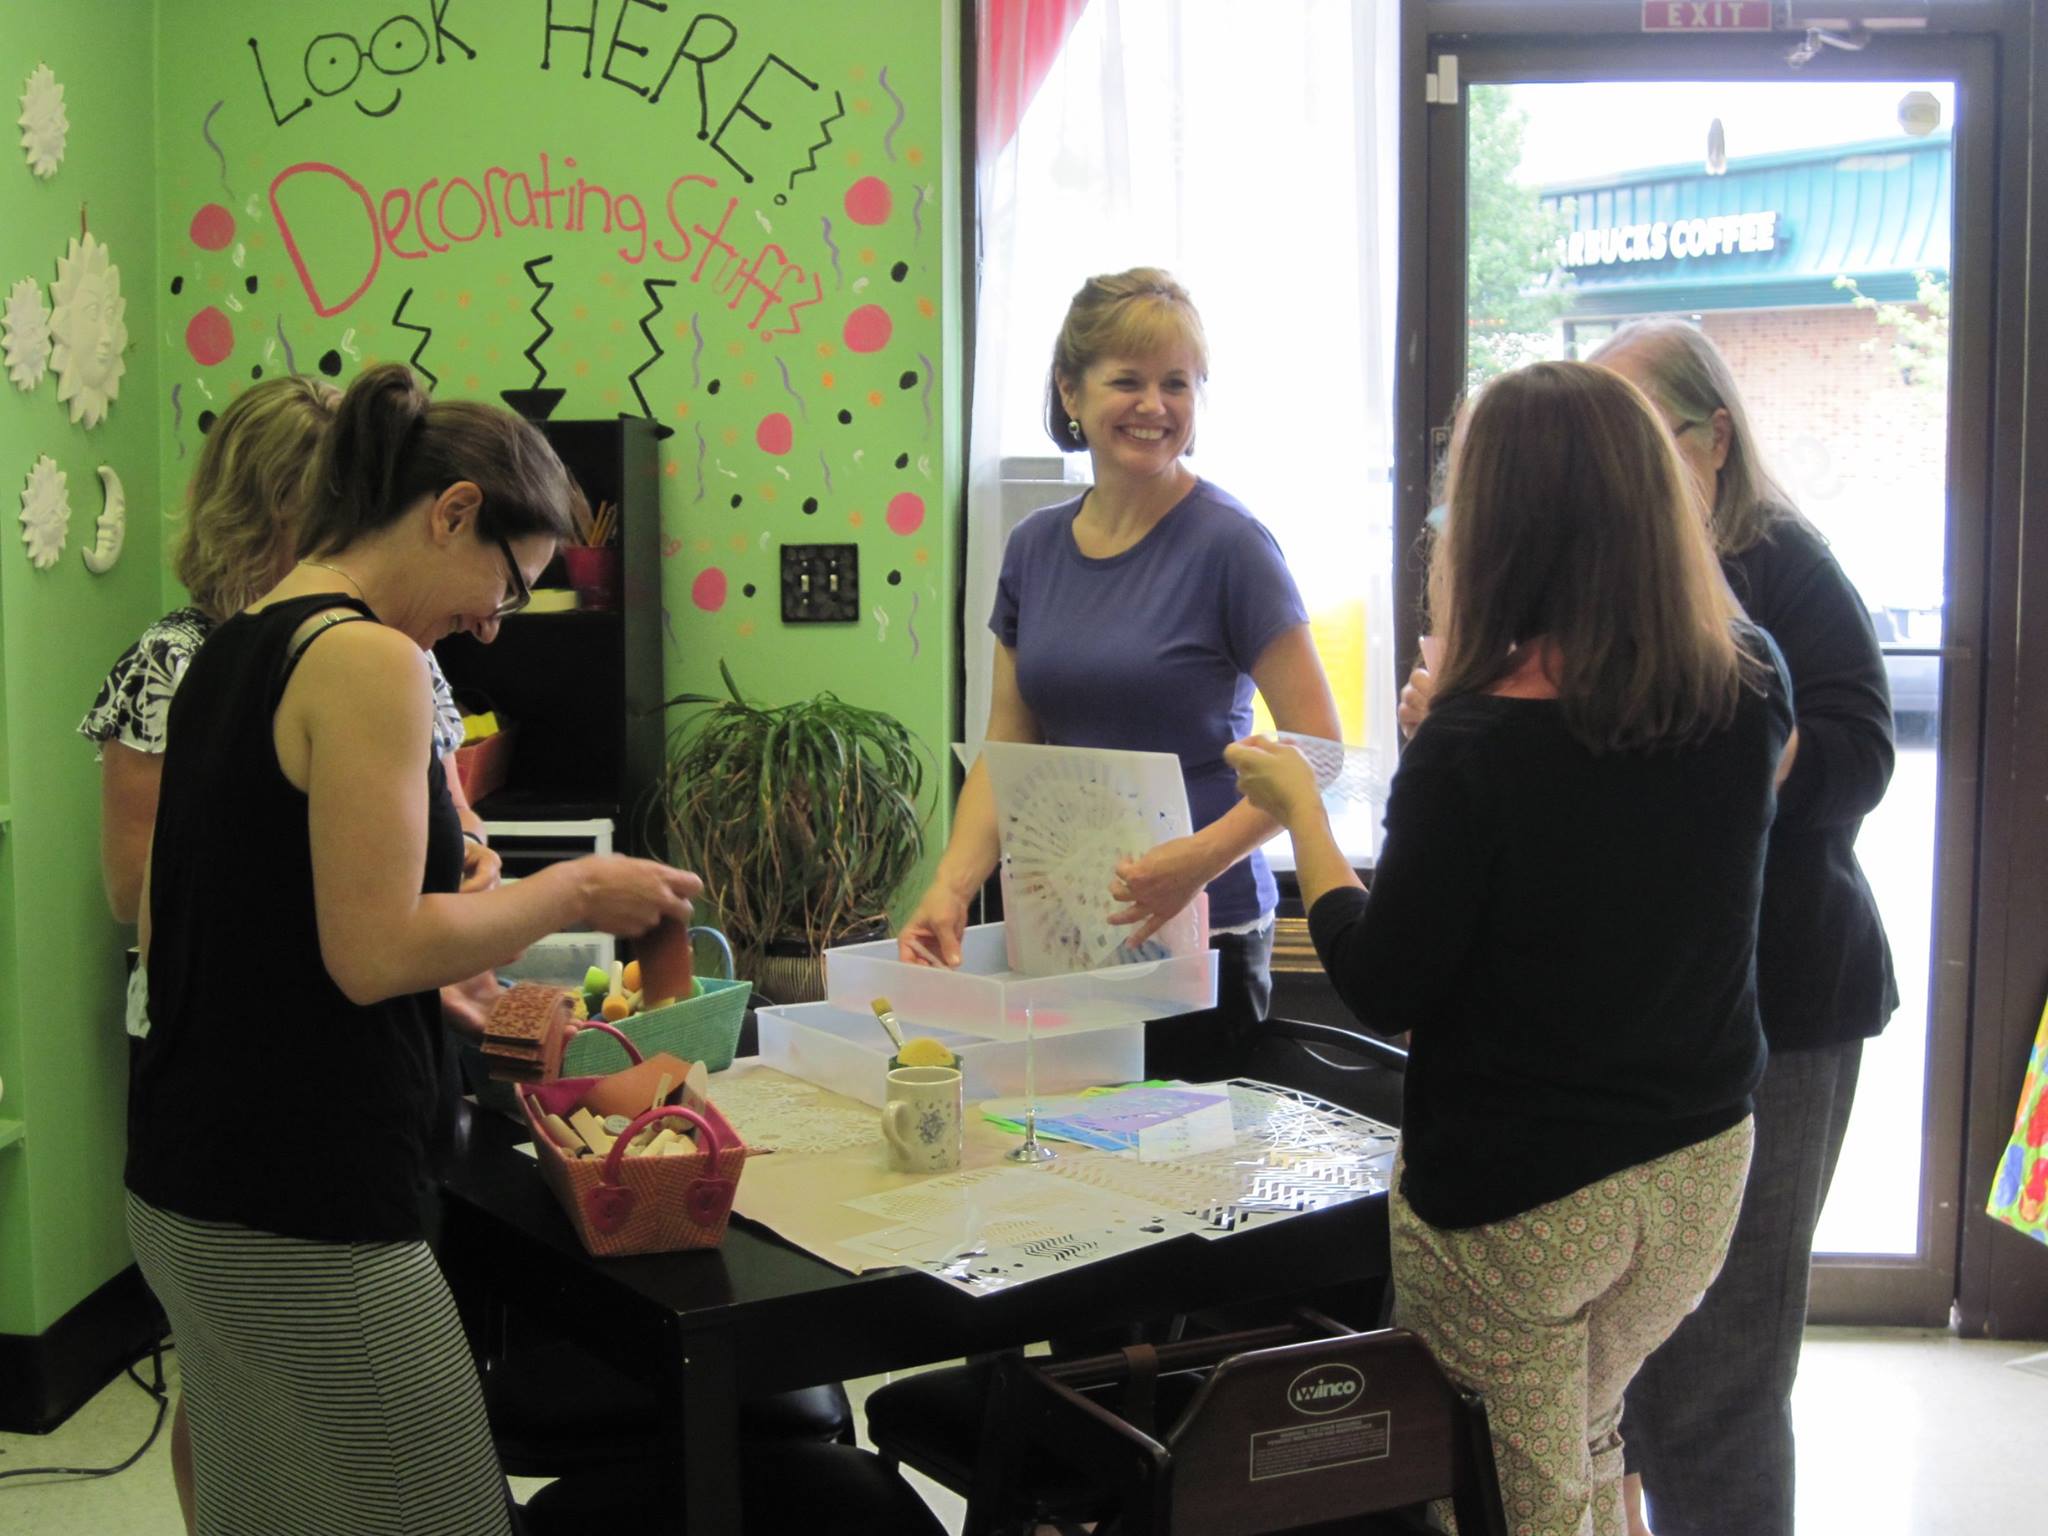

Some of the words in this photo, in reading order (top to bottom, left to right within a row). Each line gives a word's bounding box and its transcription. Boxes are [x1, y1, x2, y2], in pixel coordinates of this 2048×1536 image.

[1667, 2, 1745, 27] EXIT
[247, 0, 476, 126] LOOK
[268, 152, 647, 317] Decorating
[1555, 221, 1668, 267] RBUCKS
[1669, 210, 1777, 259] COFFEE
